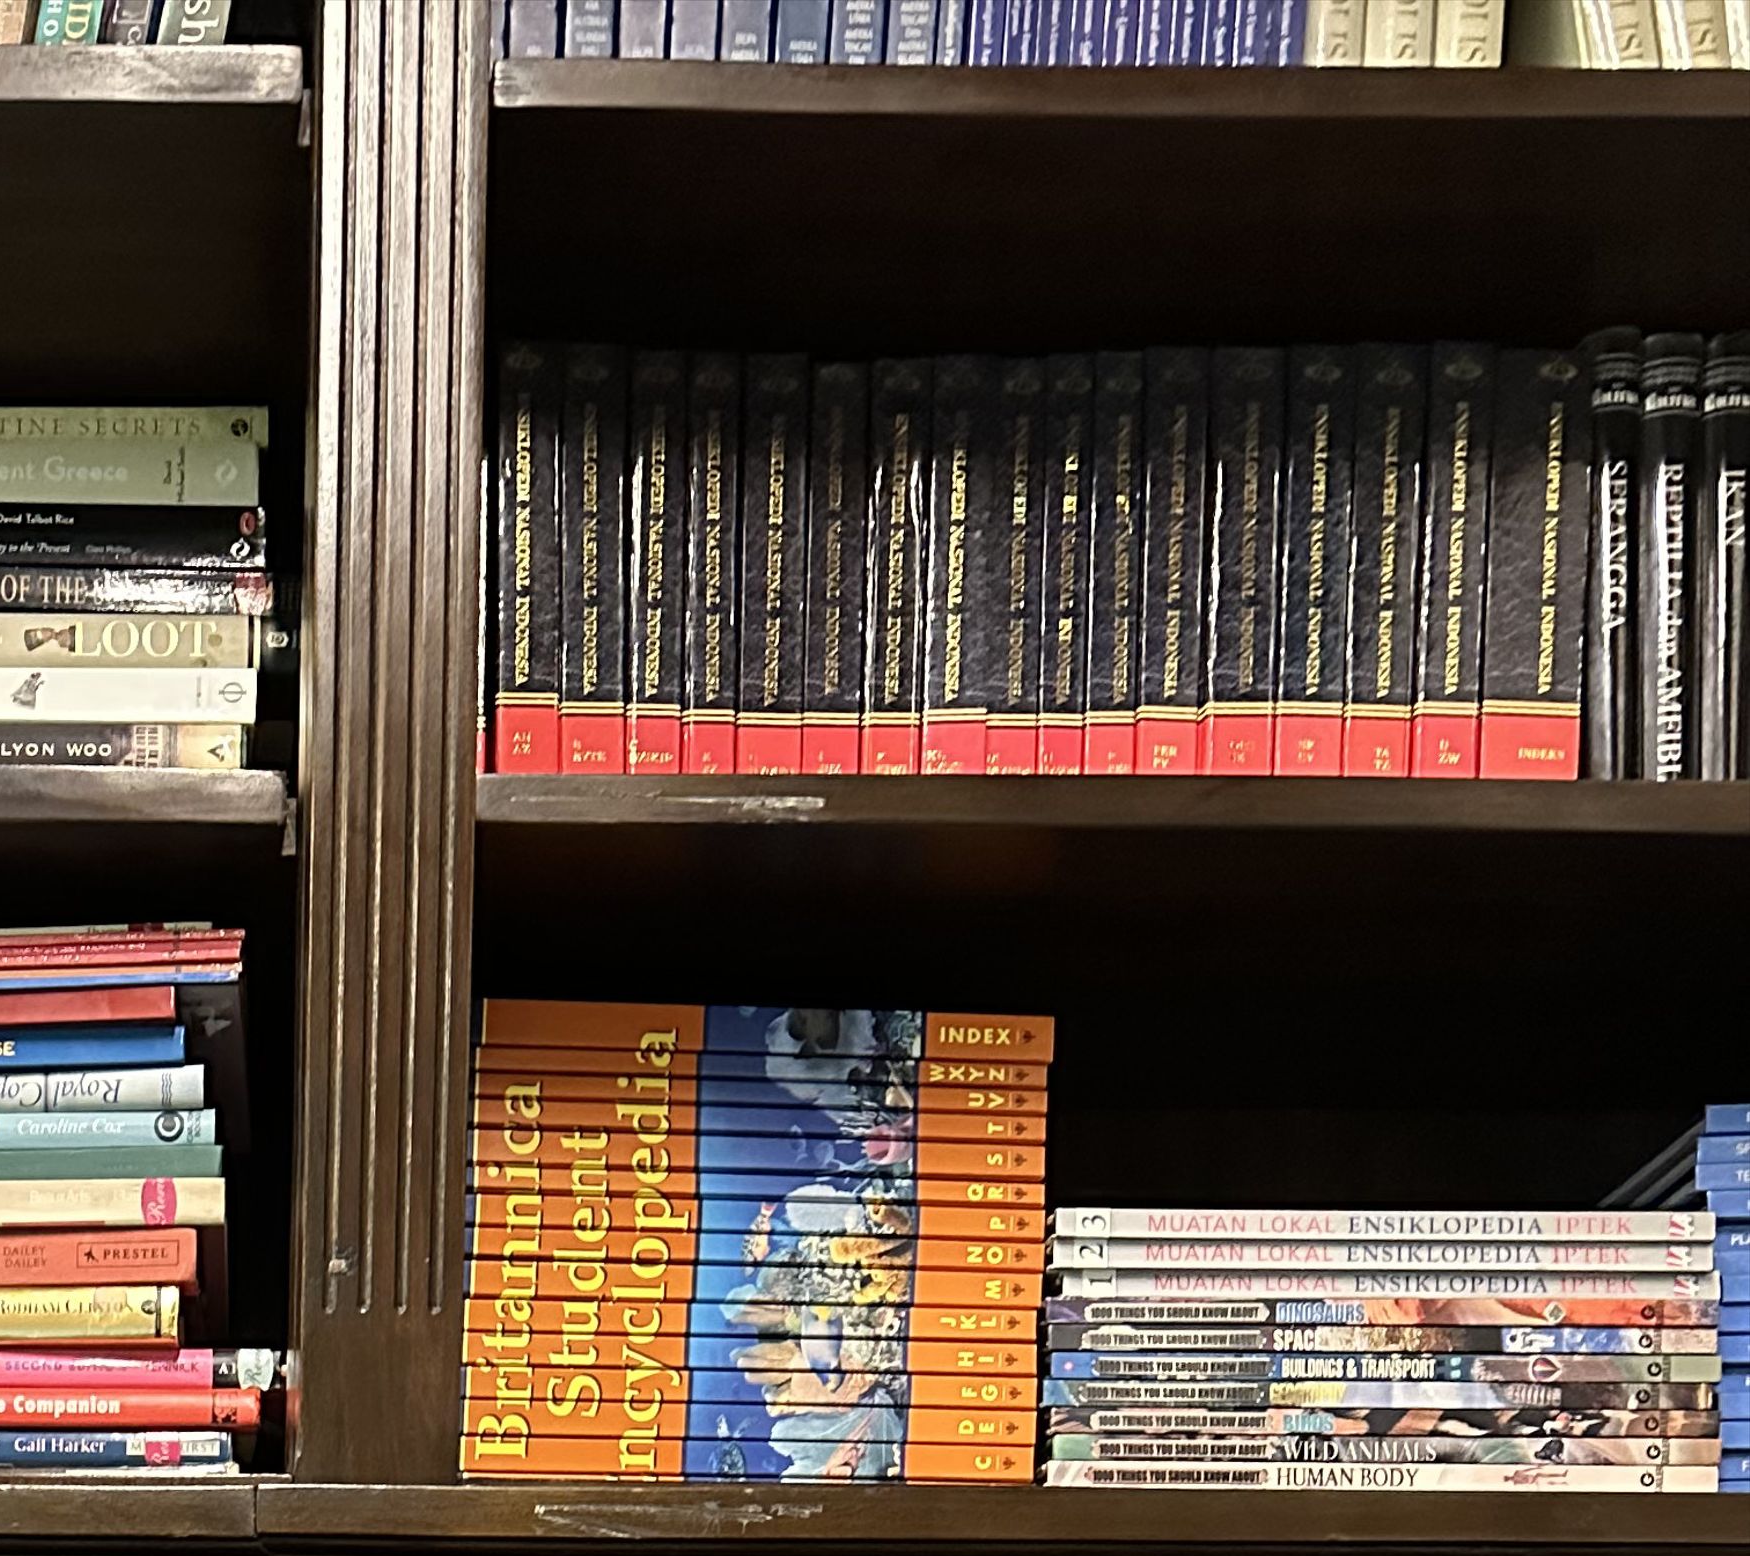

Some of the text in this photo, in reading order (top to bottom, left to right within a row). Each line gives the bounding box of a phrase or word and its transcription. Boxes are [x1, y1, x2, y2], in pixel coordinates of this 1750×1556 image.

[79, 417, 201, 437] SECRETS
[1601, 459, 1628, 632] SERANGGA
[0, 574, 31, 602] OF
[39, 576, 86, 604] THE
[73, 621, 216, 658] LOOT
[67, 743, 112, 758] WOO
[1519, 748, 1564, 763] INDEKS
[939, 1026, 1011, 1046] INDEX
[1147, 1213, 1633, 1237] MUATAN LOKAL ENSIKLOPEDIA IPTEK
[103, 1246, 170, 1260] PRESTEL
[474, 1080, 544, 1460] Britannica
[546, 1126, 611, 1418] Student
[13, 1396, 120, 1418] Companion
[1276, 1467, 1419, 1488] HUMAN BODY
